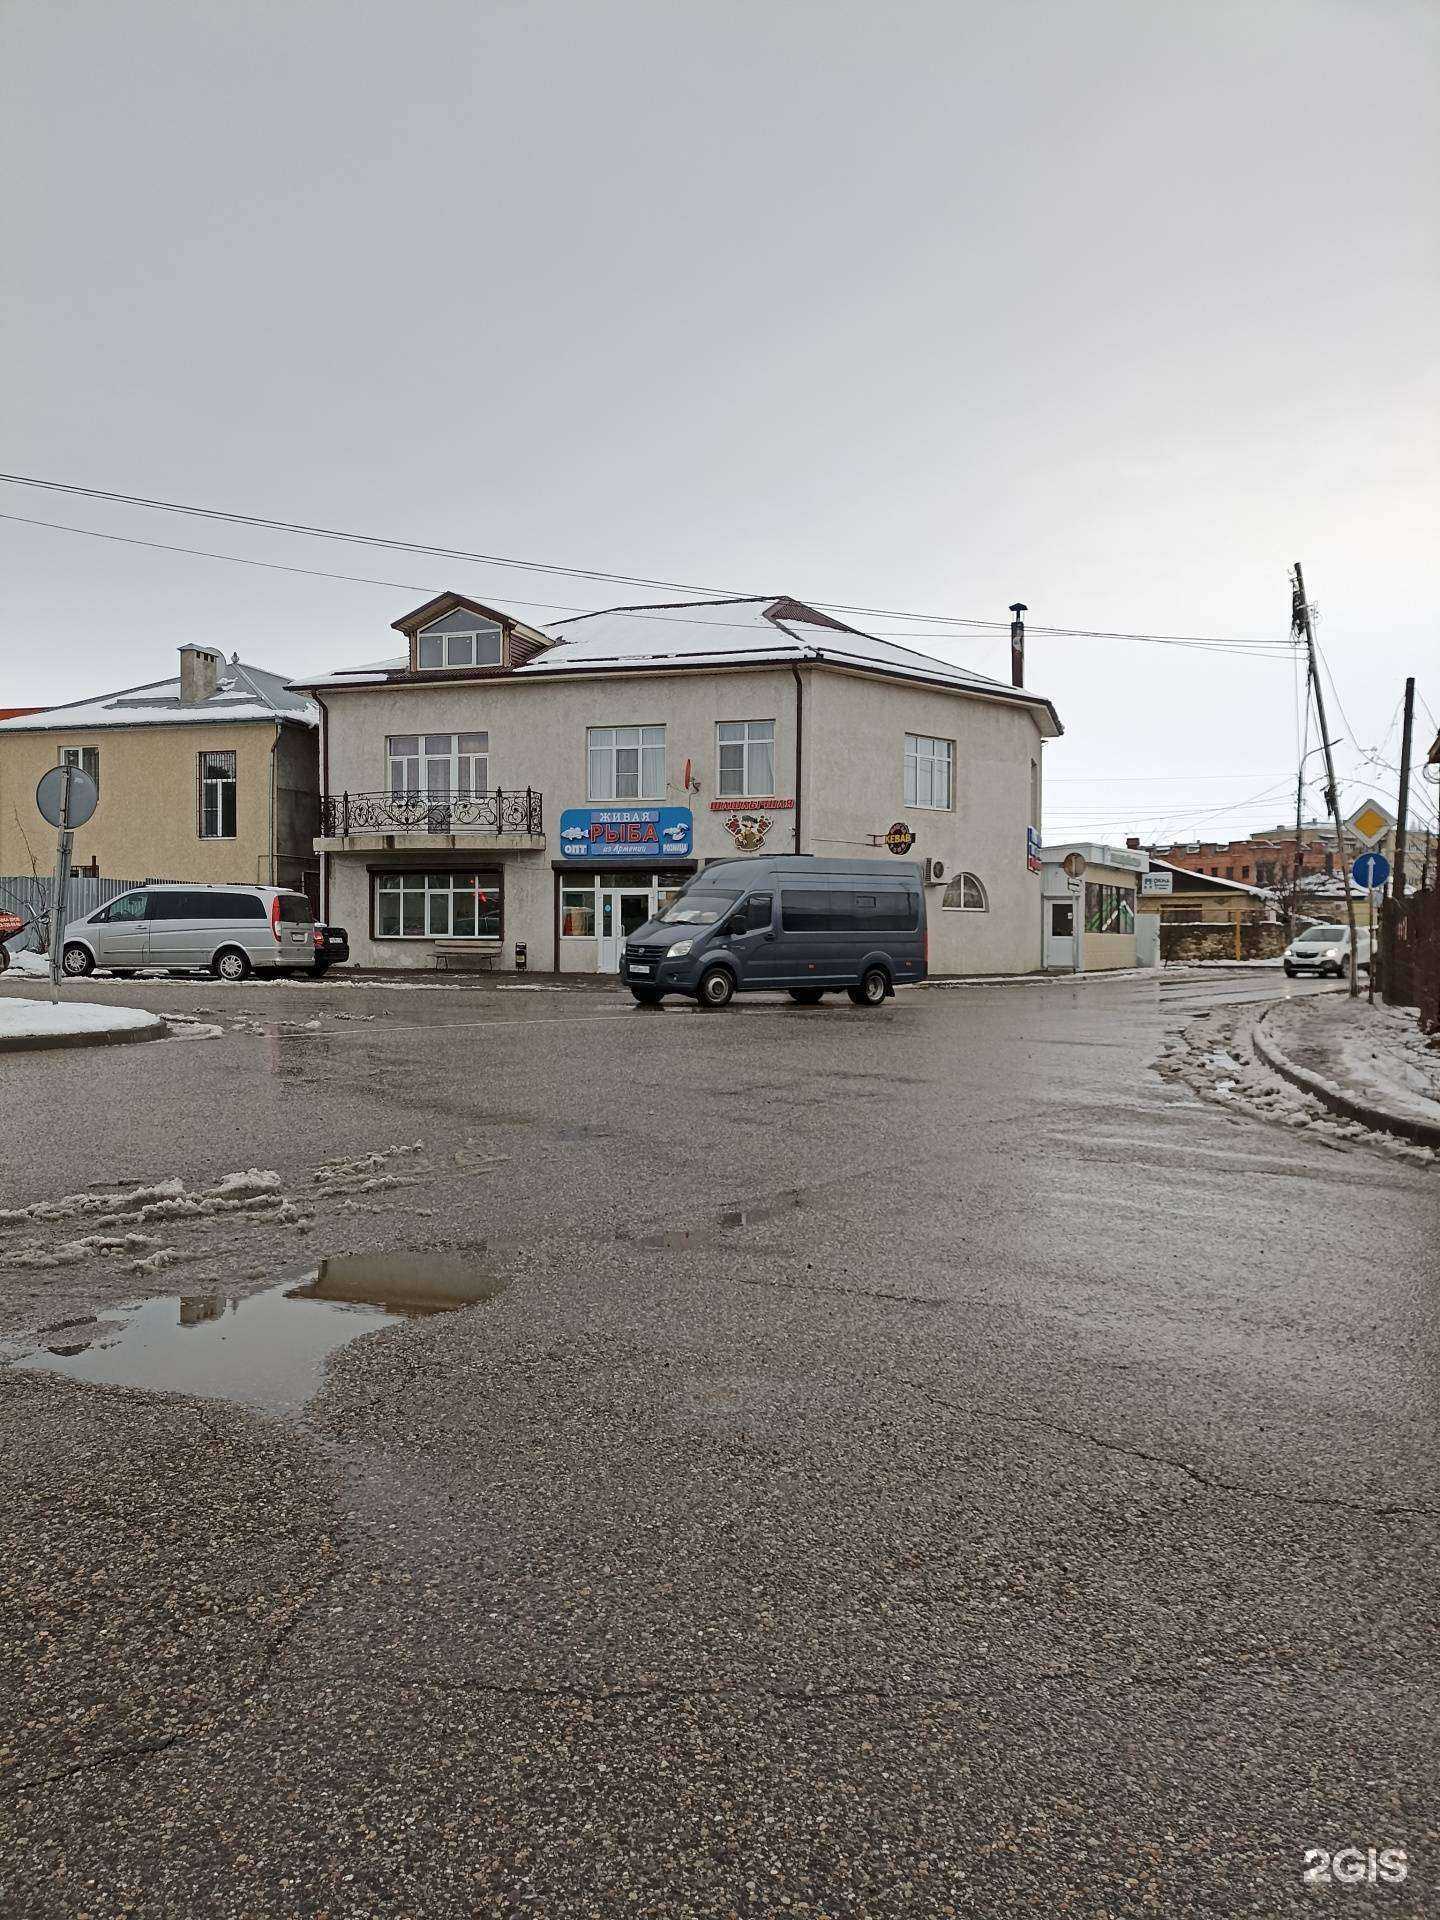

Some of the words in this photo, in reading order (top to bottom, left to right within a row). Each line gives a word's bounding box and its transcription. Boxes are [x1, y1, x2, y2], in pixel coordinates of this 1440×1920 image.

[600, 812, 649, 822] ЖИВАЯ
[590, 824, 659, 842] РЫБА
[885, 833, 911, 844] KEBAB
[564, 845, 586, 854] ОПТ
[603, 846, 612, 854] из
